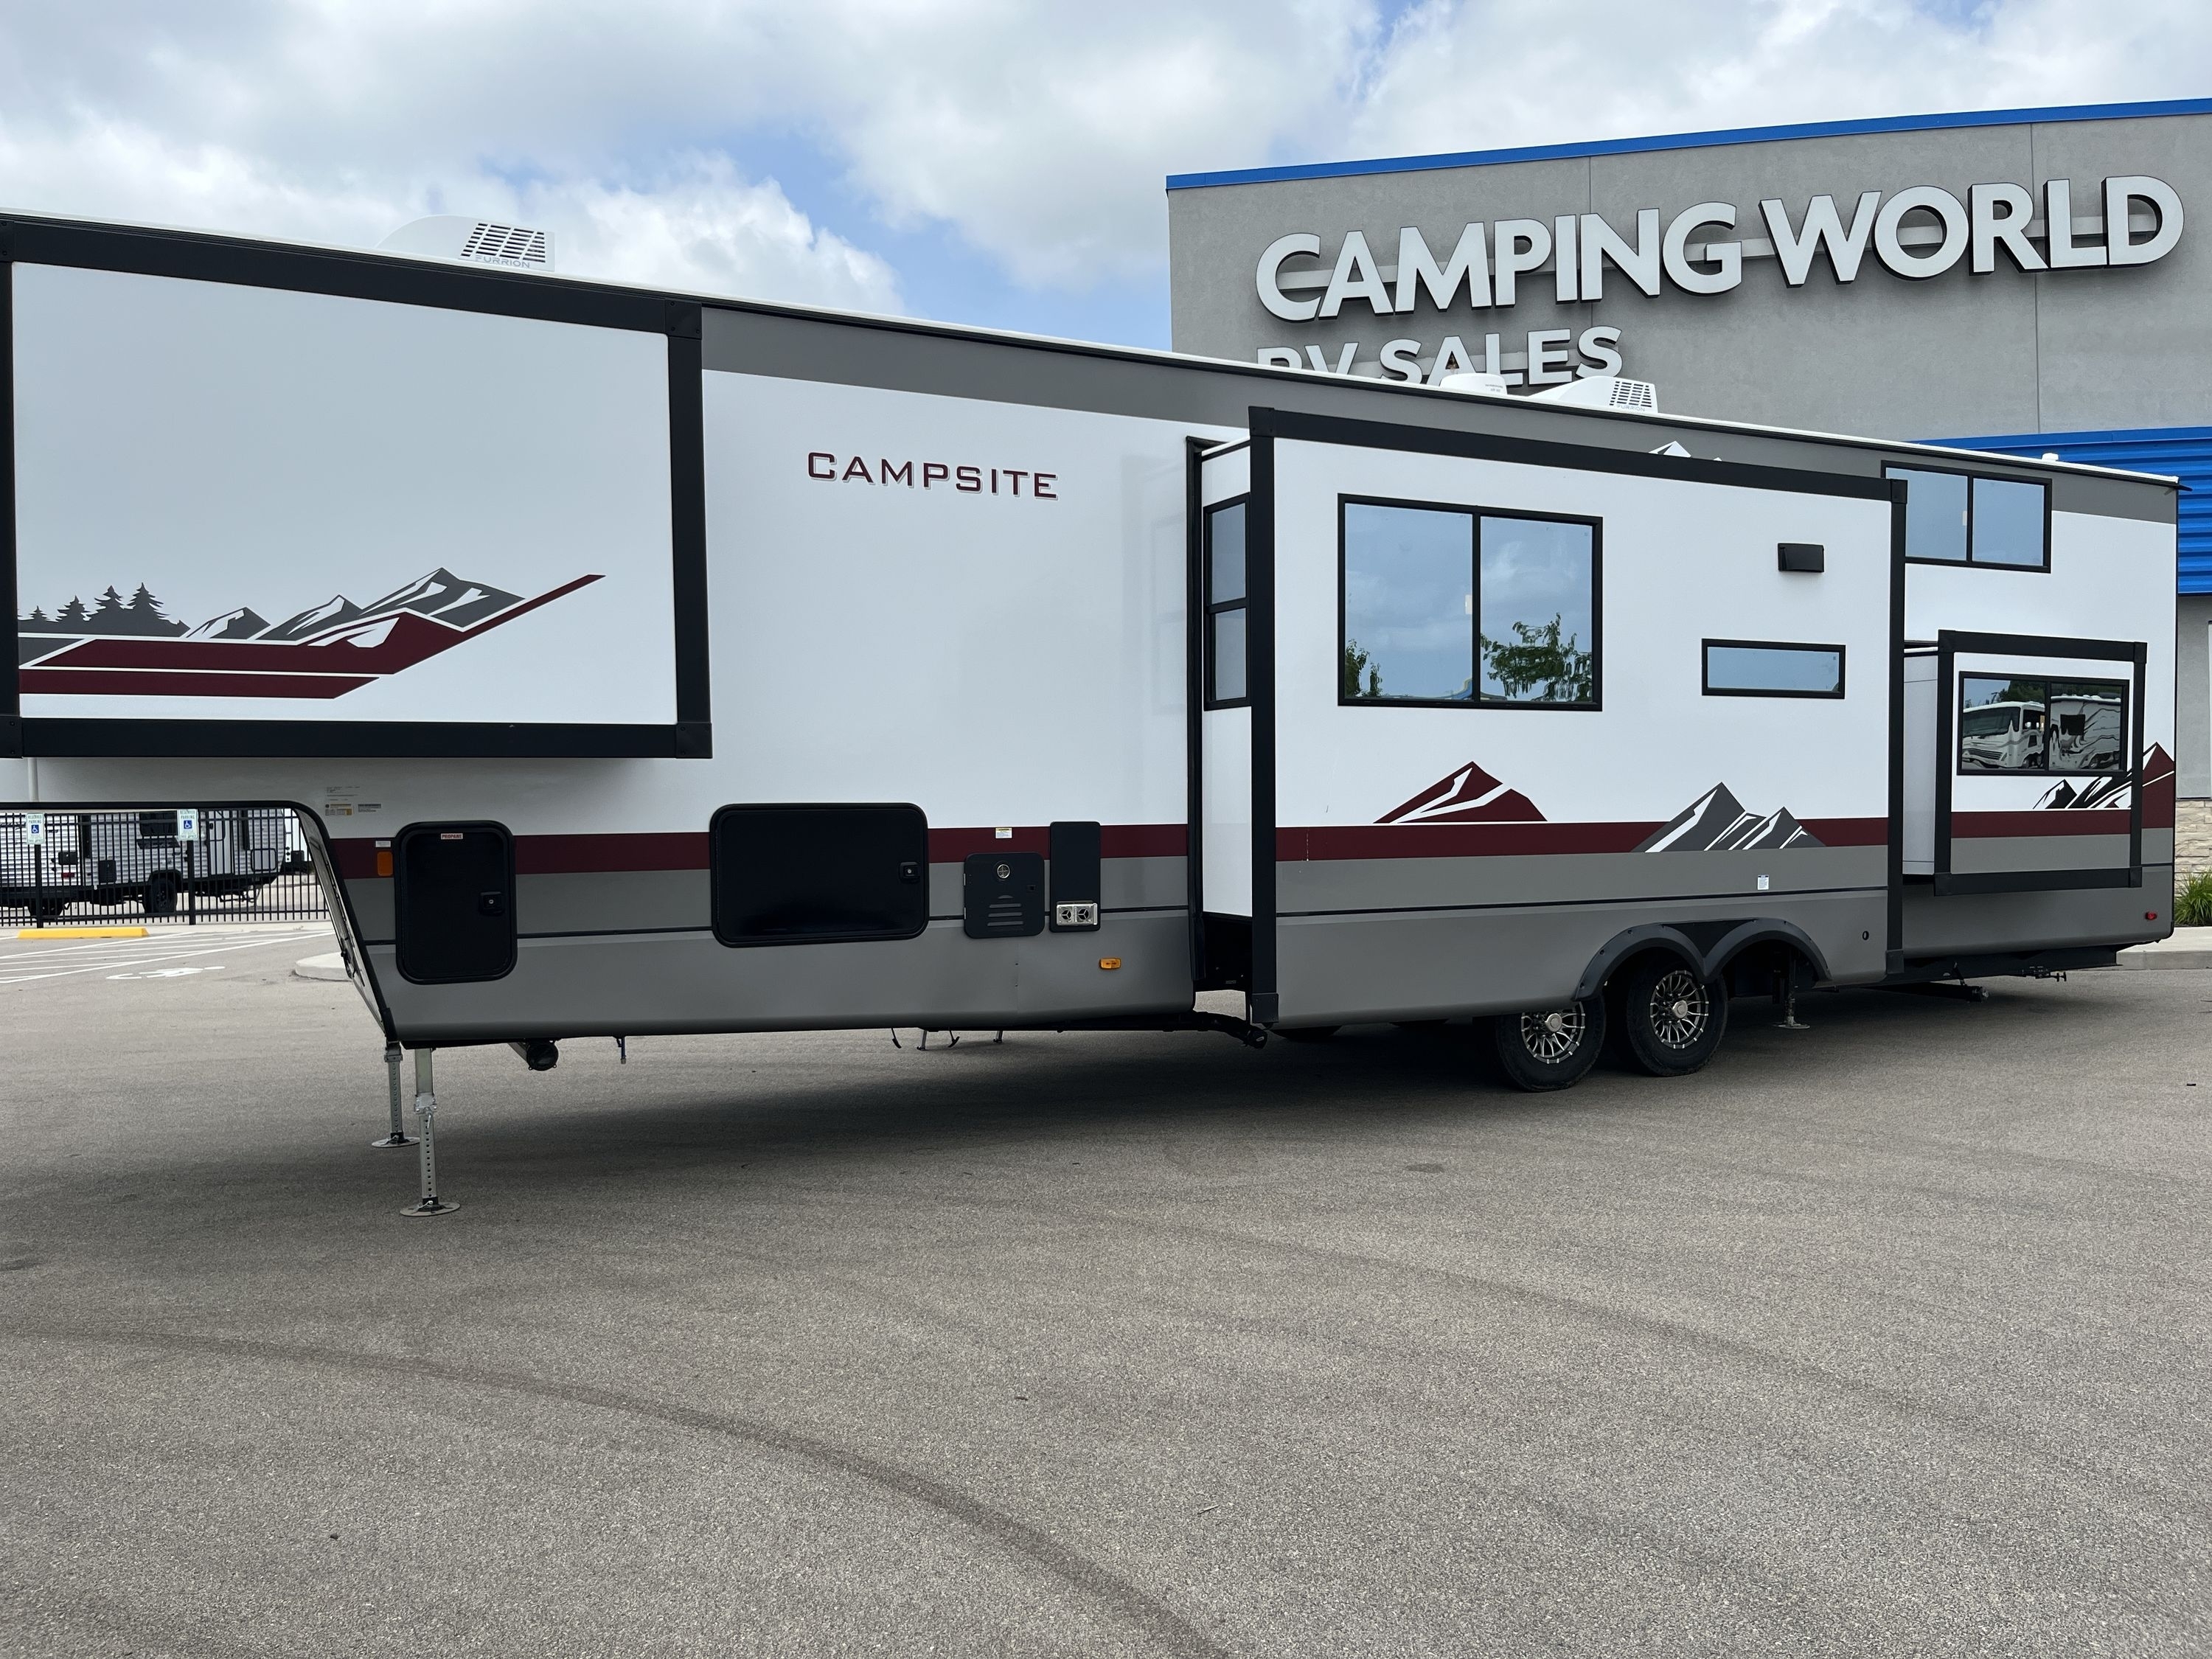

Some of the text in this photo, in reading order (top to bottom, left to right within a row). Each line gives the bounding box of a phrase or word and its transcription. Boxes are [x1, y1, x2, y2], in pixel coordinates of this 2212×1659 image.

[476, 255, 530, 268] FURRION
[1256, 175, 2185, 321] CAMPING WORLD
[1380, 325, 1623, 386] SALES
[808, 452, 1058, 499] CAMPSITE
